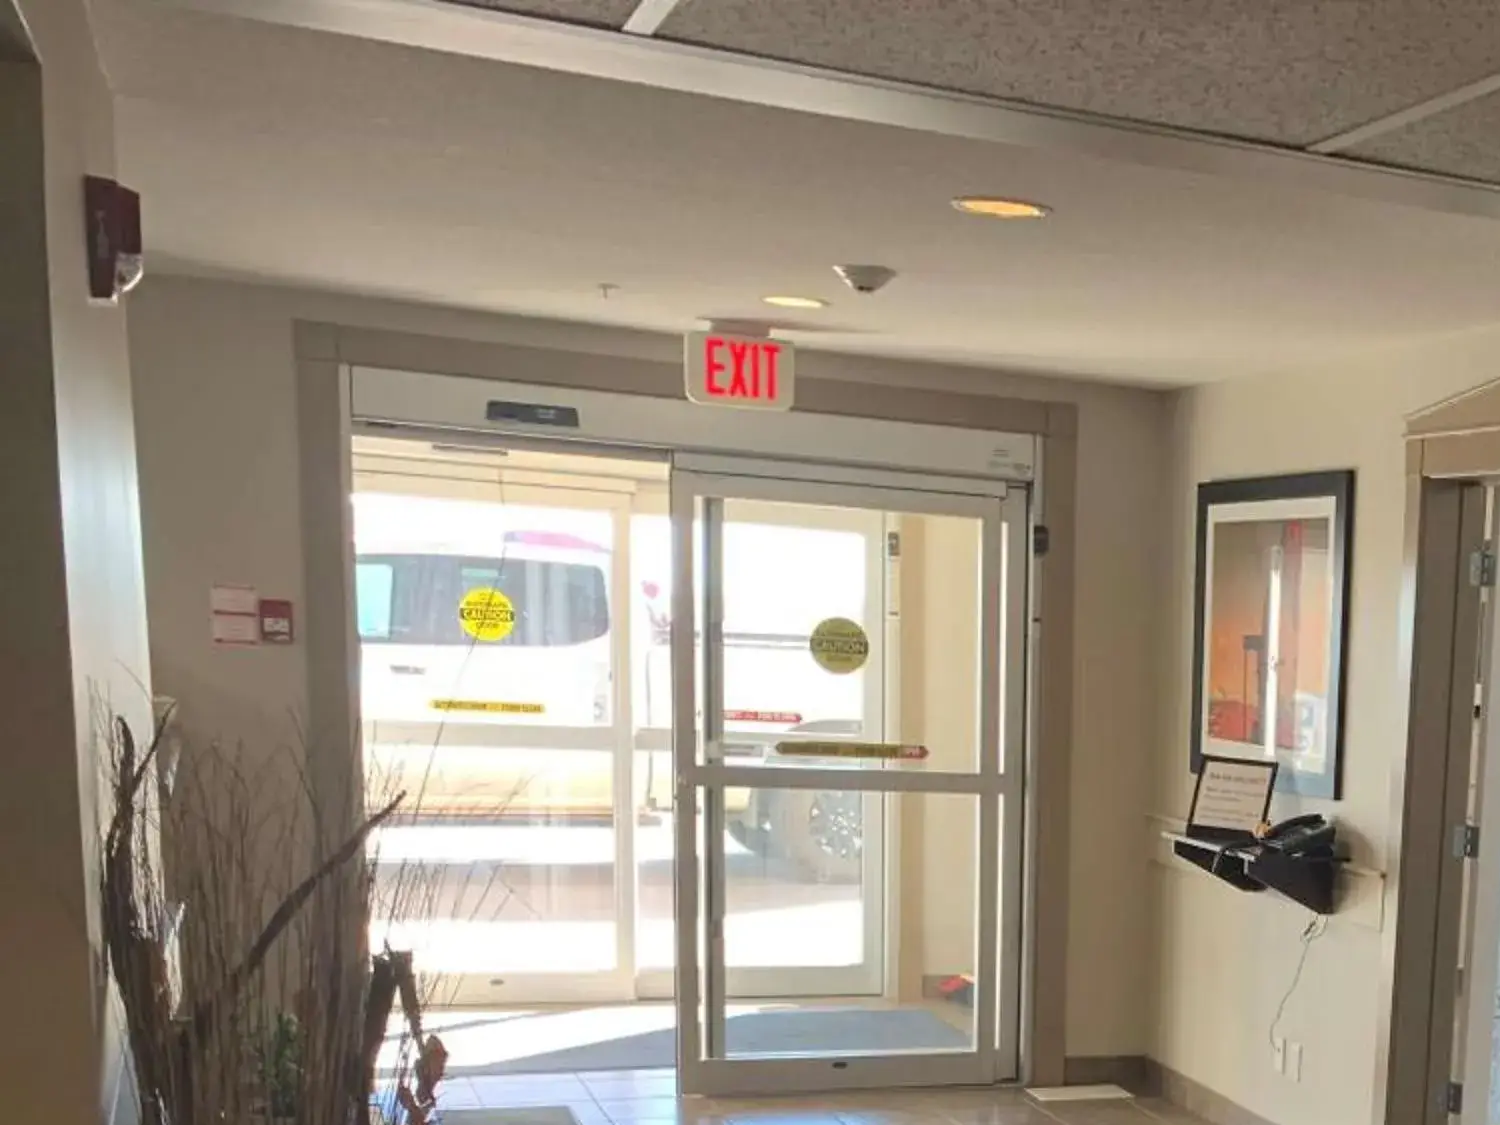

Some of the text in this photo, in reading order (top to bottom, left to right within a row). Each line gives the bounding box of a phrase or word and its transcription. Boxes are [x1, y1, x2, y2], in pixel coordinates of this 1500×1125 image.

[705, 336, 781, 401] EXIT
[463, 608, 510, 621] CAUTION
[814, 638, 866, 655] CAUTION
